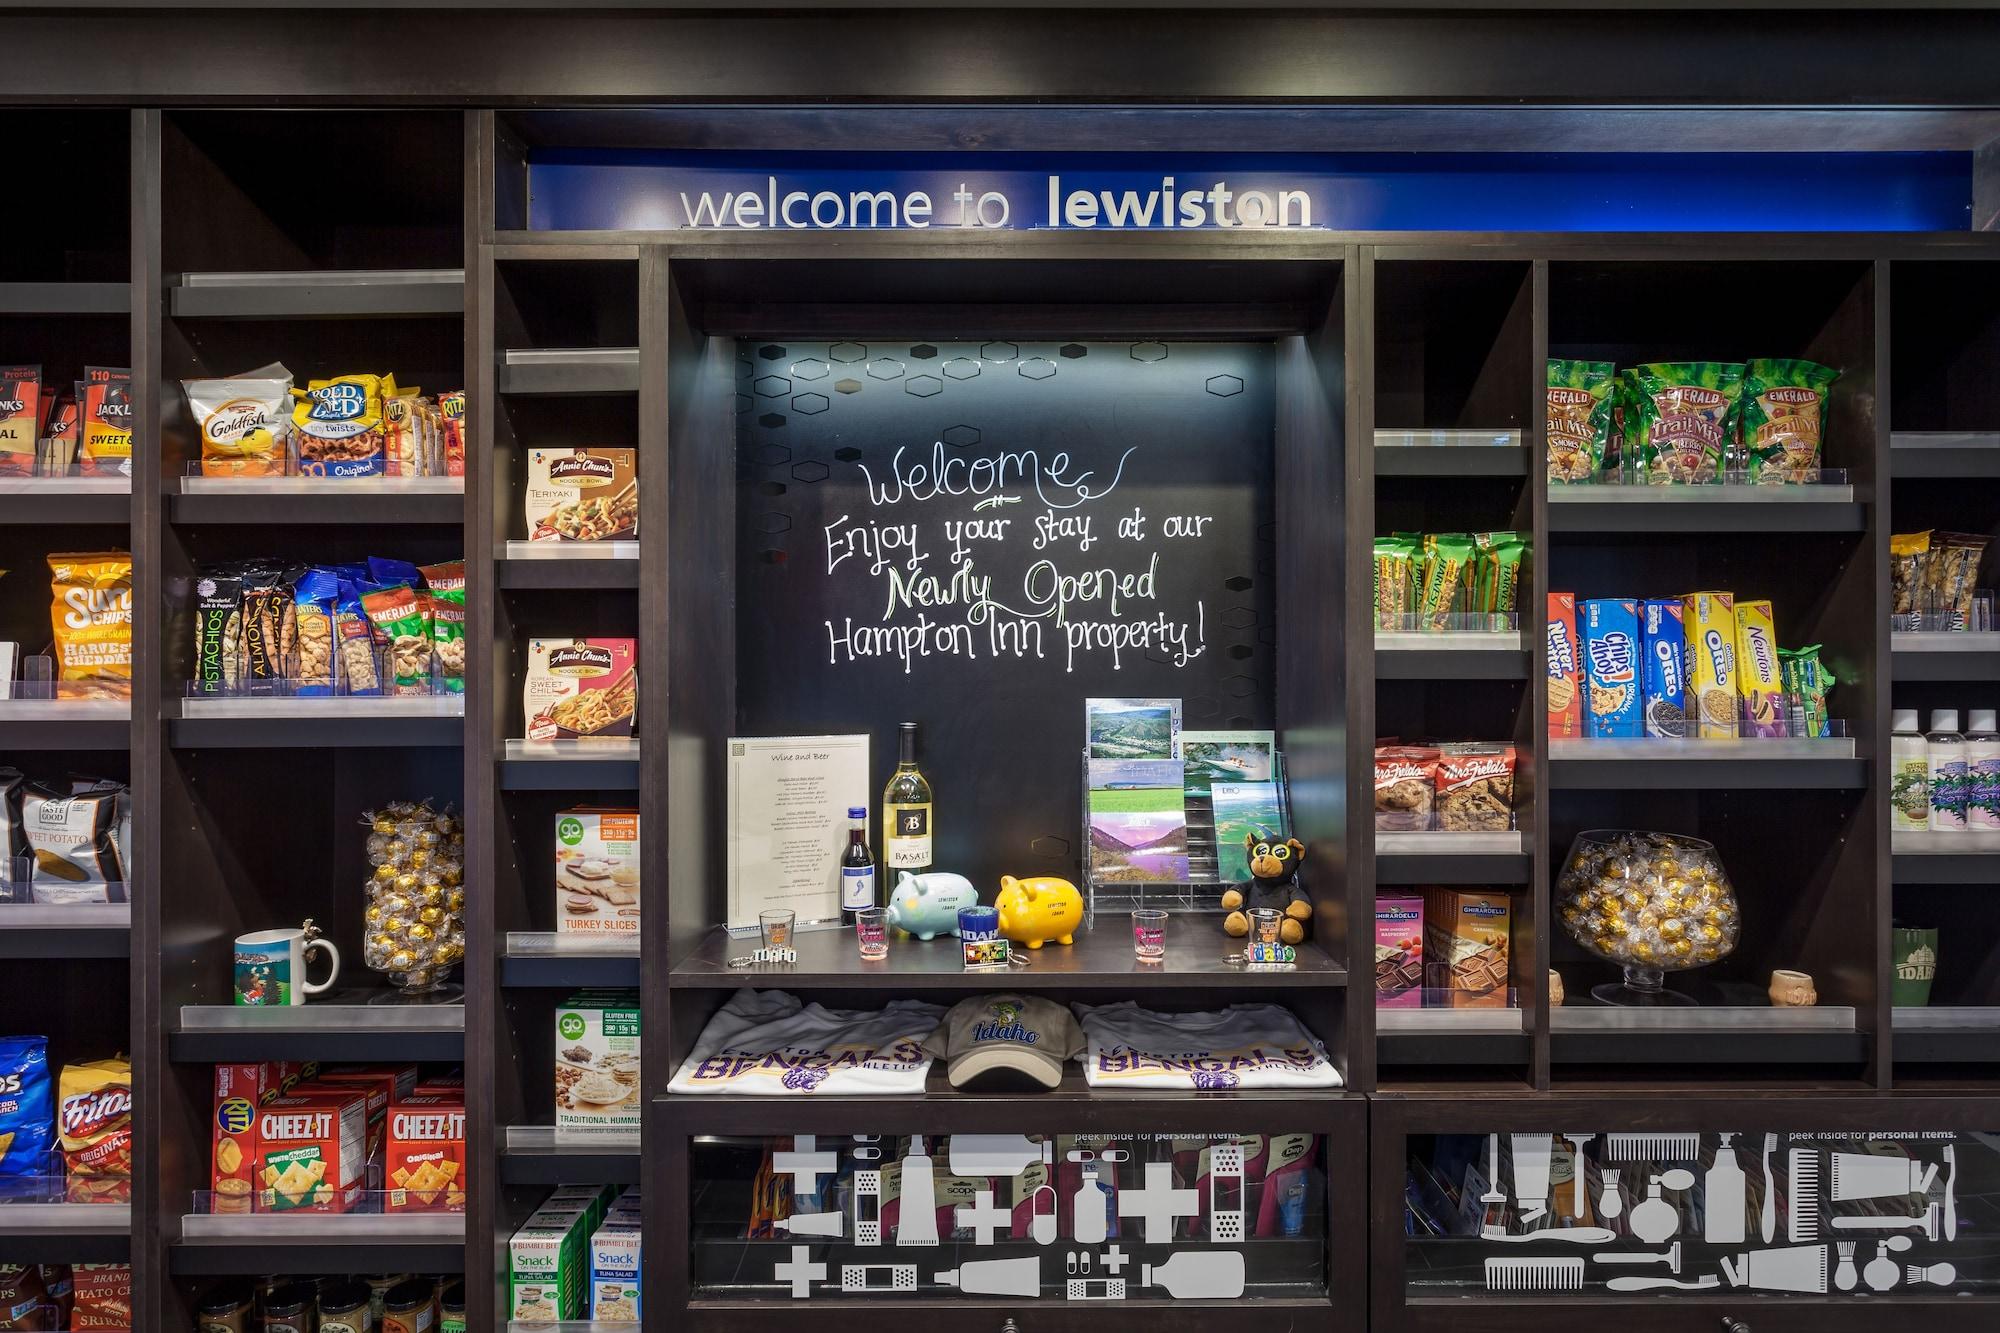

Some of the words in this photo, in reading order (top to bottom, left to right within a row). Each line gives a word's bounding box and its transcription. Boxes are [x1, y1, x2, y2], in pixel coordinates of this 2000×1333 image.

[680, 176, 933, 228] welcome
[953, 183, 1010, 228] to
[1048, 175, 1312, 228] lewiston
[90, 370, 110, 381] 110
[1667, 388, 1720, 404] EMERALD
[1769, 391, 1815, 402] EMERALD
[96, 404, 123, 416] JACK
[385, 401, 405, 418] RITZ
[443, 400, 464, 416] RITZ
[211, 411, 265, 438] Goldfish
[310, 425, 326, 434] tiny
[325, 424, 356, 433] twists
[1567, 419, 1595, 439] Mix
[1655, 417, 1692, 437] Trail
[1695, 421, 1721, 447] Mix
[1760, 418, 1801, 440] Trail
[90, 435, 125, 445] SWEET
[334, 460, 375, 478] Original
[551, 460, 580, 475] Annie
[582, 459, 612, 472] Chun's
[858, 442, 1137, 509] Welcome
[530, 489, 573, 498] TERIYAKI
[825, 515, 929, 576] Enjoy
[944, 517, 1011, 564] your
[1033, 509, 1098, 551] stay
[1118, 507, 1146, 541] at
[1163, 513, 1213, 538] our
[883, 558, 992, 626] Newly
[1024, 551, 1160, 628] Opened
[1429, 558, 1447, 608] HARVEST
[1499, 565, 1511, 612] HARVEST
[64, 587, 131, 629] Sun
[373, 604, 418, 622] EMERALD
[92, 611, 132, 626] CHIPS
[247, 597, 267, 677] ALMONDS
[825, 613, 976, 673] Hampton
[988, 605, 1044, 658] Inn
[1065, 600, 1207, 673] property!
[204, 610, 223, 692] PISTACHIOS
[1547, 621, 1574, 672] Nutter
[1605, 632, 1629, 673] Chips
[1747, 626, 1772, 684] Newtons
[550, 650, 580, 665] Annie
[581, 650, 611, 662] Chun's
[1706, 630, 1728, 685] OREO
[1725, 643, 1734, 672] Golden
[1656, 640, 1677, 697] OREO
[1619, 682, 1635, 714] ORIGINAL
[813, 752, 830, 760] Beer
[1467, 759, 1508, 779] Fields
[42, 813, 63, 821] GOOD
[49, 832, 88, 844] POTATO
[561, 823, 580, 838] go
[895, 851, 929, 860] BASALT
[565, 919, 601, 928] TURKEY
[604, 920, 637, 930] SLICES
[962, 930, 999, 941] IDAH
[1250, 943, 1296, 962] Idaho
[562, 1018, 582, 1033] go
[970, 1021, 1041, 1045] Idaho
[1099, 1048, 1316, 1073] BENGALS
[63, 1091, 131, 1133] Fritos
[224, 1102, 249, 1132] RITZ
[560, 1115, 608, 1124] TRADITIONAL
[1075, 1133, 1100, 1142] peek
[1155, 1133, 1204, 1142] personal
[1789, 1132, 1814, 1141] peek
[1869, 1132, 1918, 1141] personal
[81, 1136, 128, 1161] ORIGINAL
[268, 1156, 290, 1164] WHITE
[289, 1148, 320, 1161] cheddar
[947, 1187, 977, 1198] scope
[517, 1255, 553, 1266] Snack
[599, 1252, 634, 1264] Snack
[93, 1273, 130, 1283] BRAND
